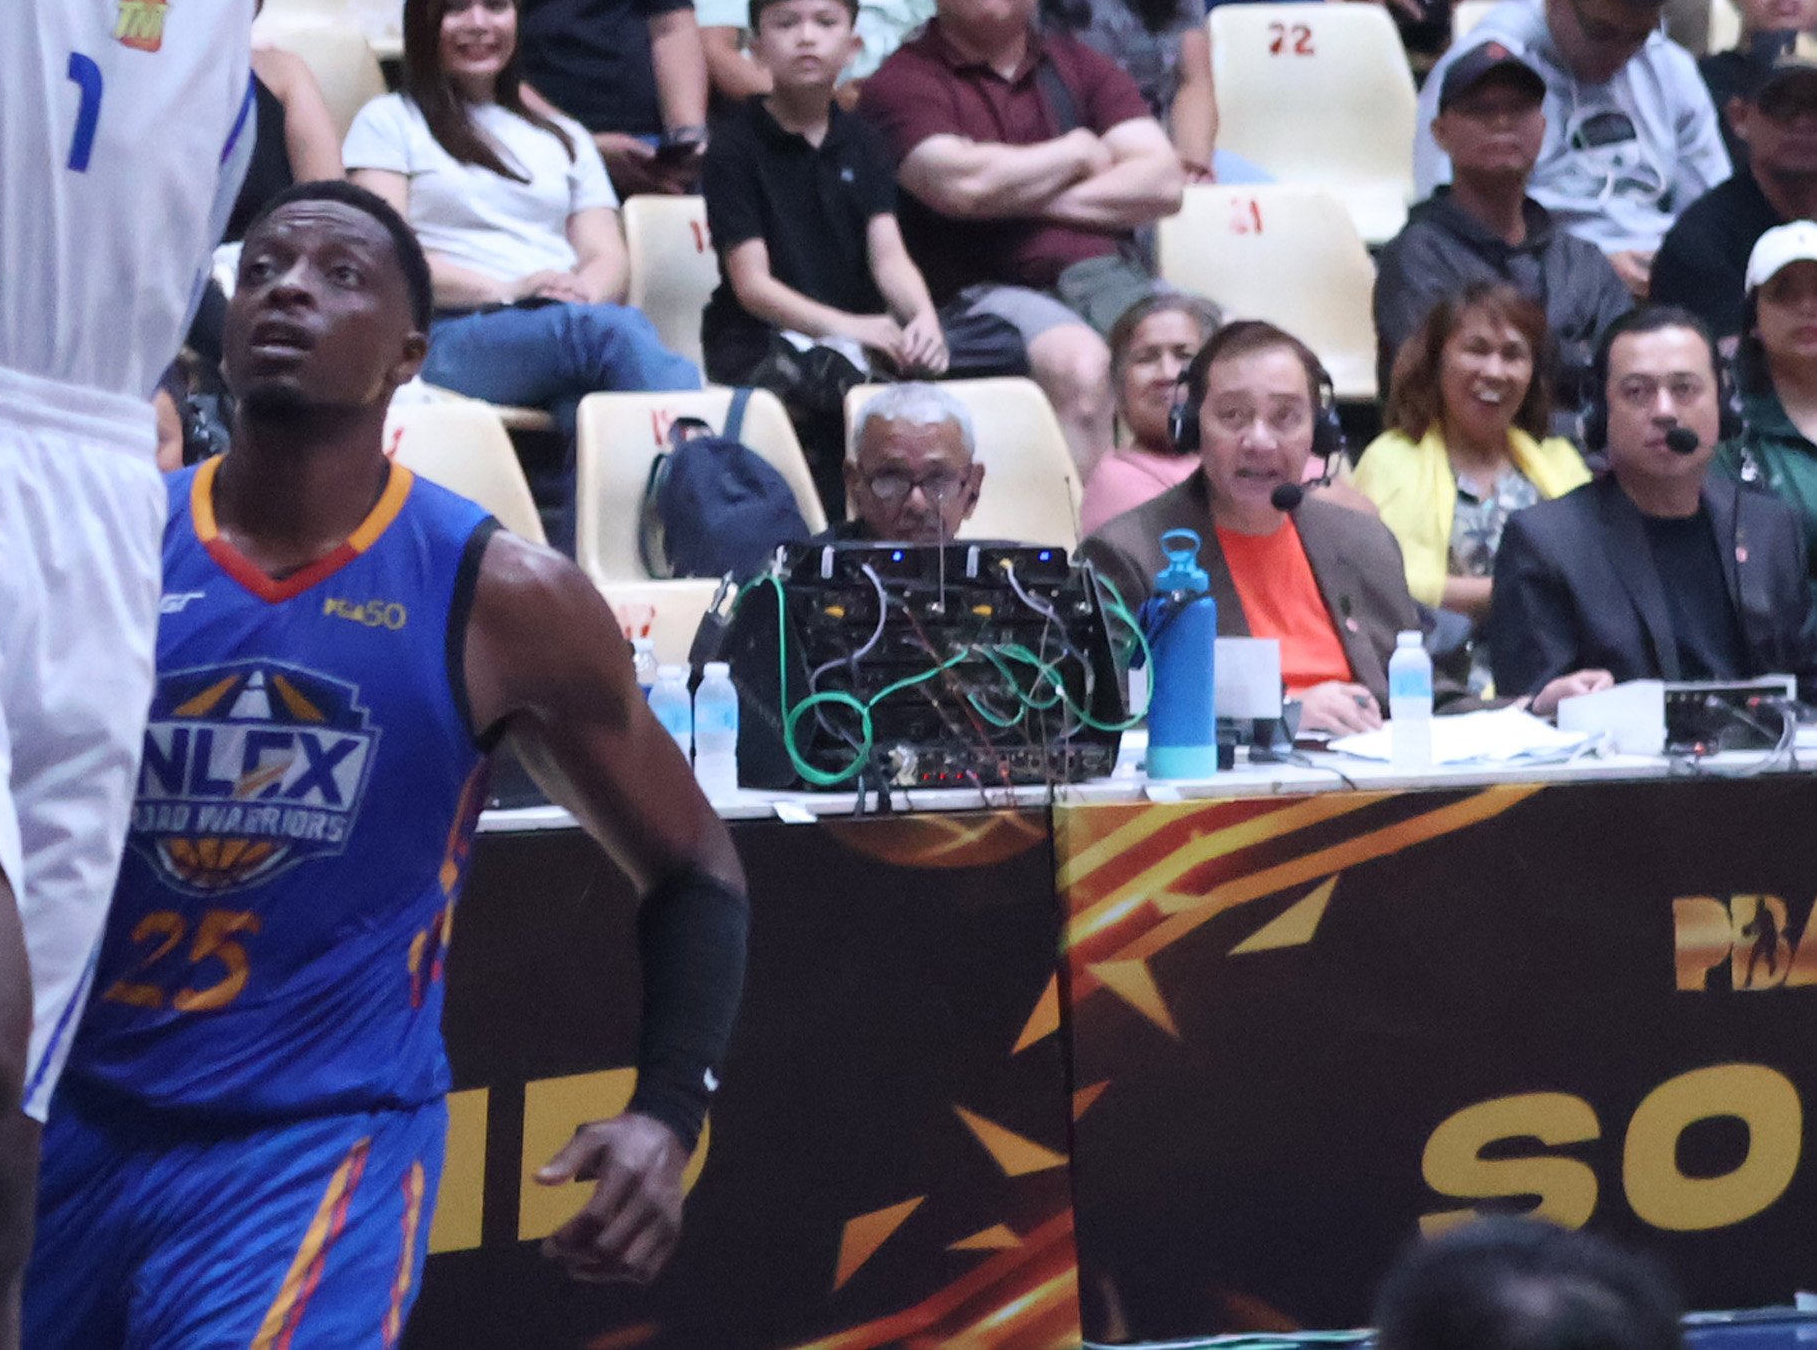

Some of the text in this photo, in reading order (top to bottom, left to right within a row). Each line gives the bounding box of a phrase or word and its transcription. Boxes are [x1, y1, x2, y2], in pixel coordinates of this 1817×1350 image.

[67, 50, 104, 174] 1
[138, 727, 361, 807] NLEX
[103, 909, 264, 1012] 25
[1418, 1061, 1804, 1246] SO
